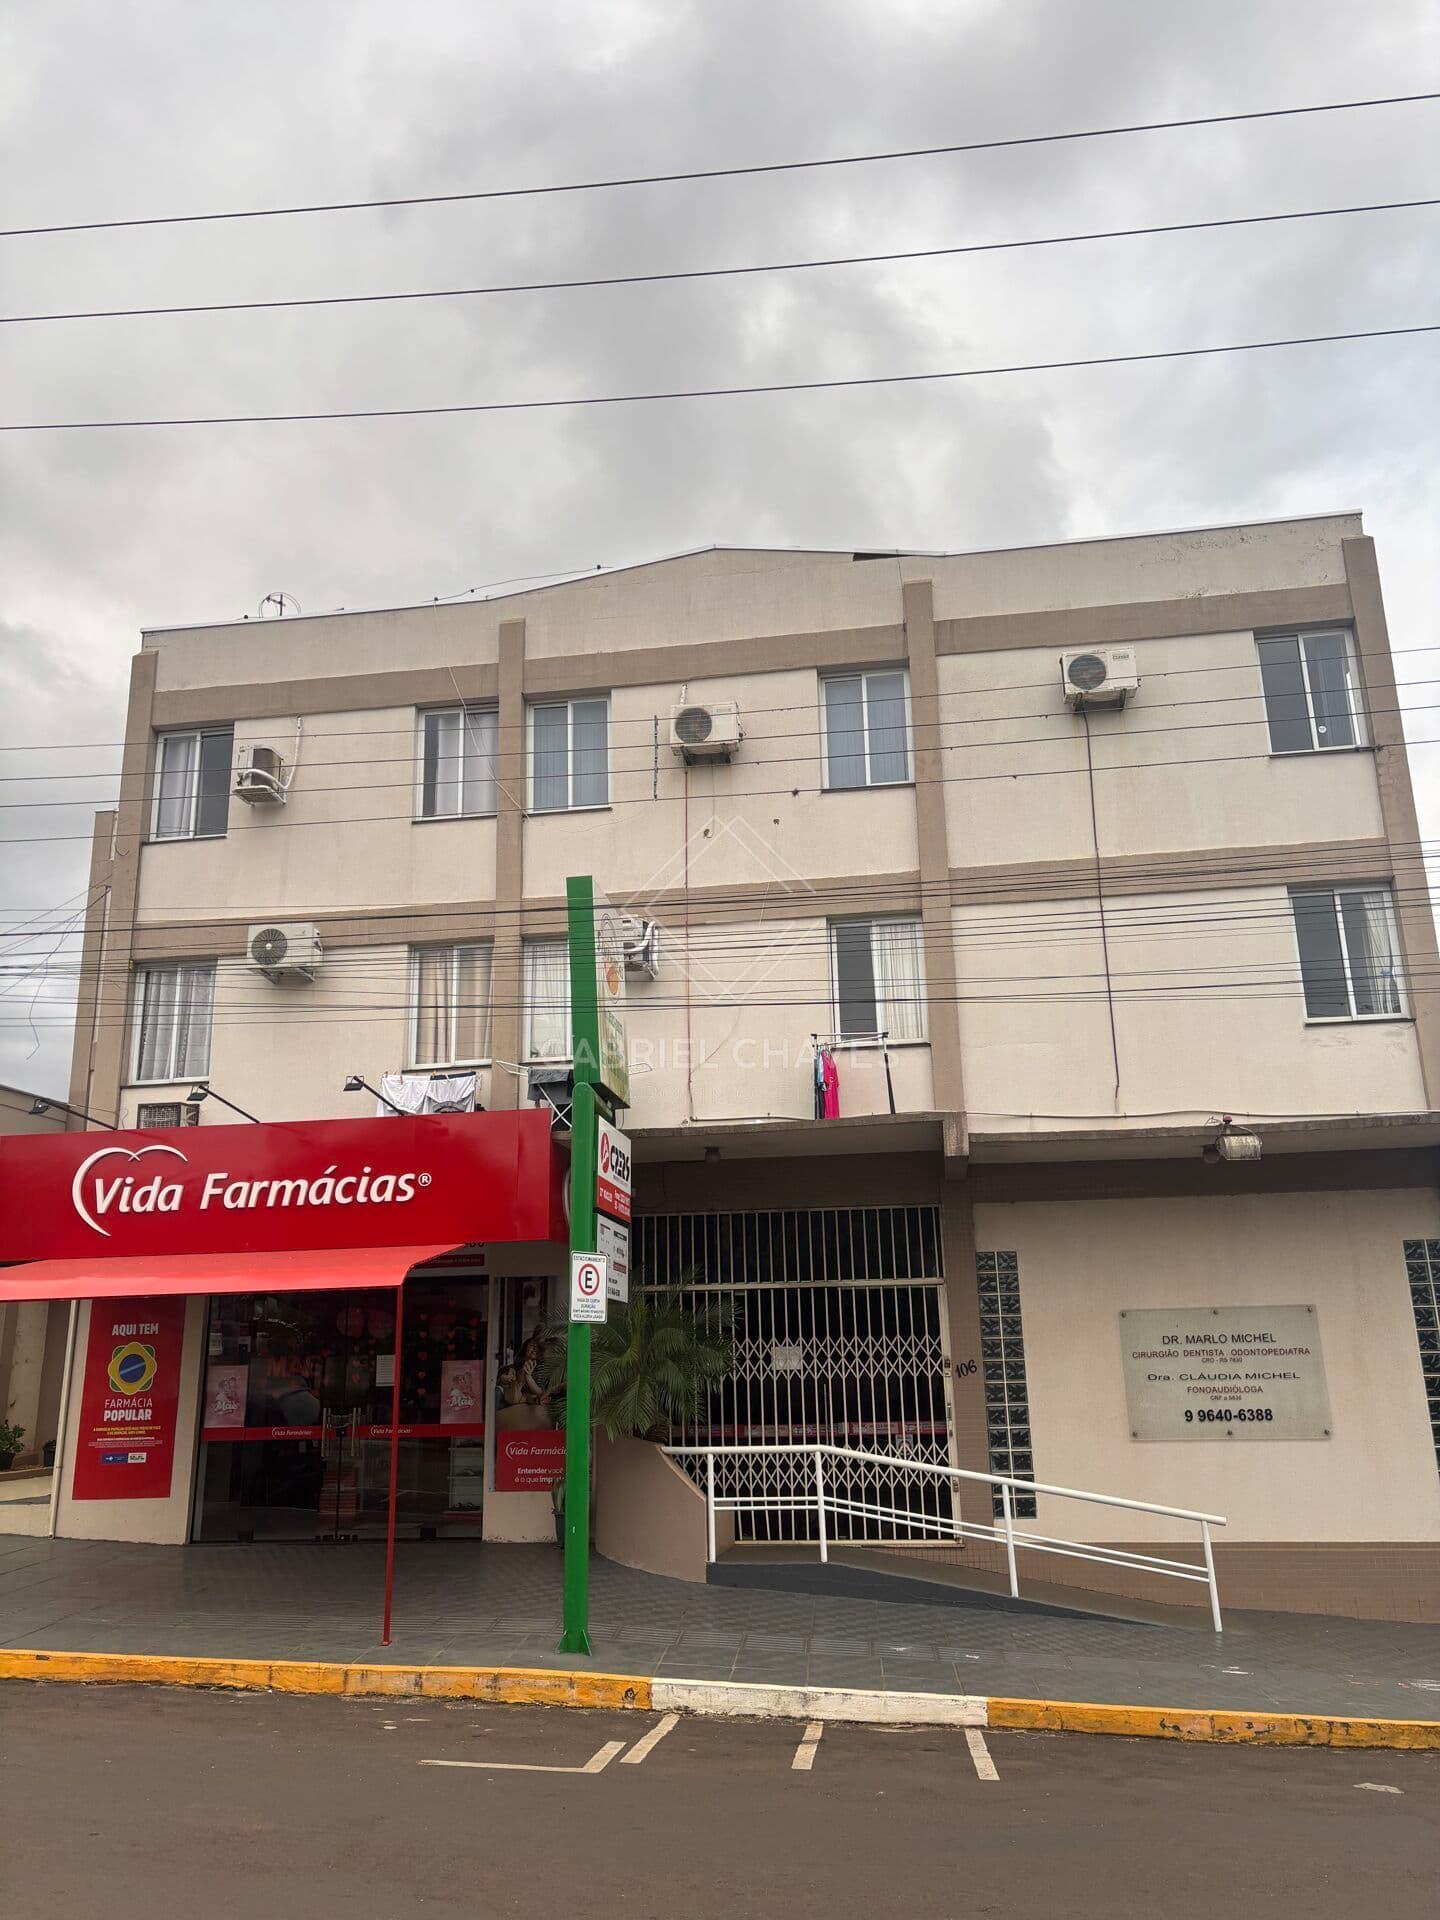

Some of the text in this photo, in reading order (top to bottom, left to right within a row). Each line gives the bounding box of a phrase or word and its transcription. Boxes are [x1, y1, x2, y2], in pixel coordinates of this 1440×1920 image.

[95, 1176, 184, 1214] Vida
[585, 1271, 592, 1288] E
[112, 1323, 159, 1336] AQUI TEM
[1162, 1333, 1276, 1344] DR. MARLO MICHEL
[1132, 1349, 1179, 1358] CIRURGIÃO
[1231, 1347, 1310, 1356] ODONTOPEDIATRA
[955, 1360, 977, 1378] 106
[1147, 1373, 1175, 1381] Dra.
[1245, 1372, 1301, 1380] MICHEL
[1187, 1384, 1263, 1394] FONOAUDIÓLOGA
[104, 1397, 153, 1408] FARMÁCIA
[103, 1409, 152, 1421] POPULAR
[1184, 1408, 1273, 1422] 9 9640-6388
[509, 1447, 528, 1455] Vida
